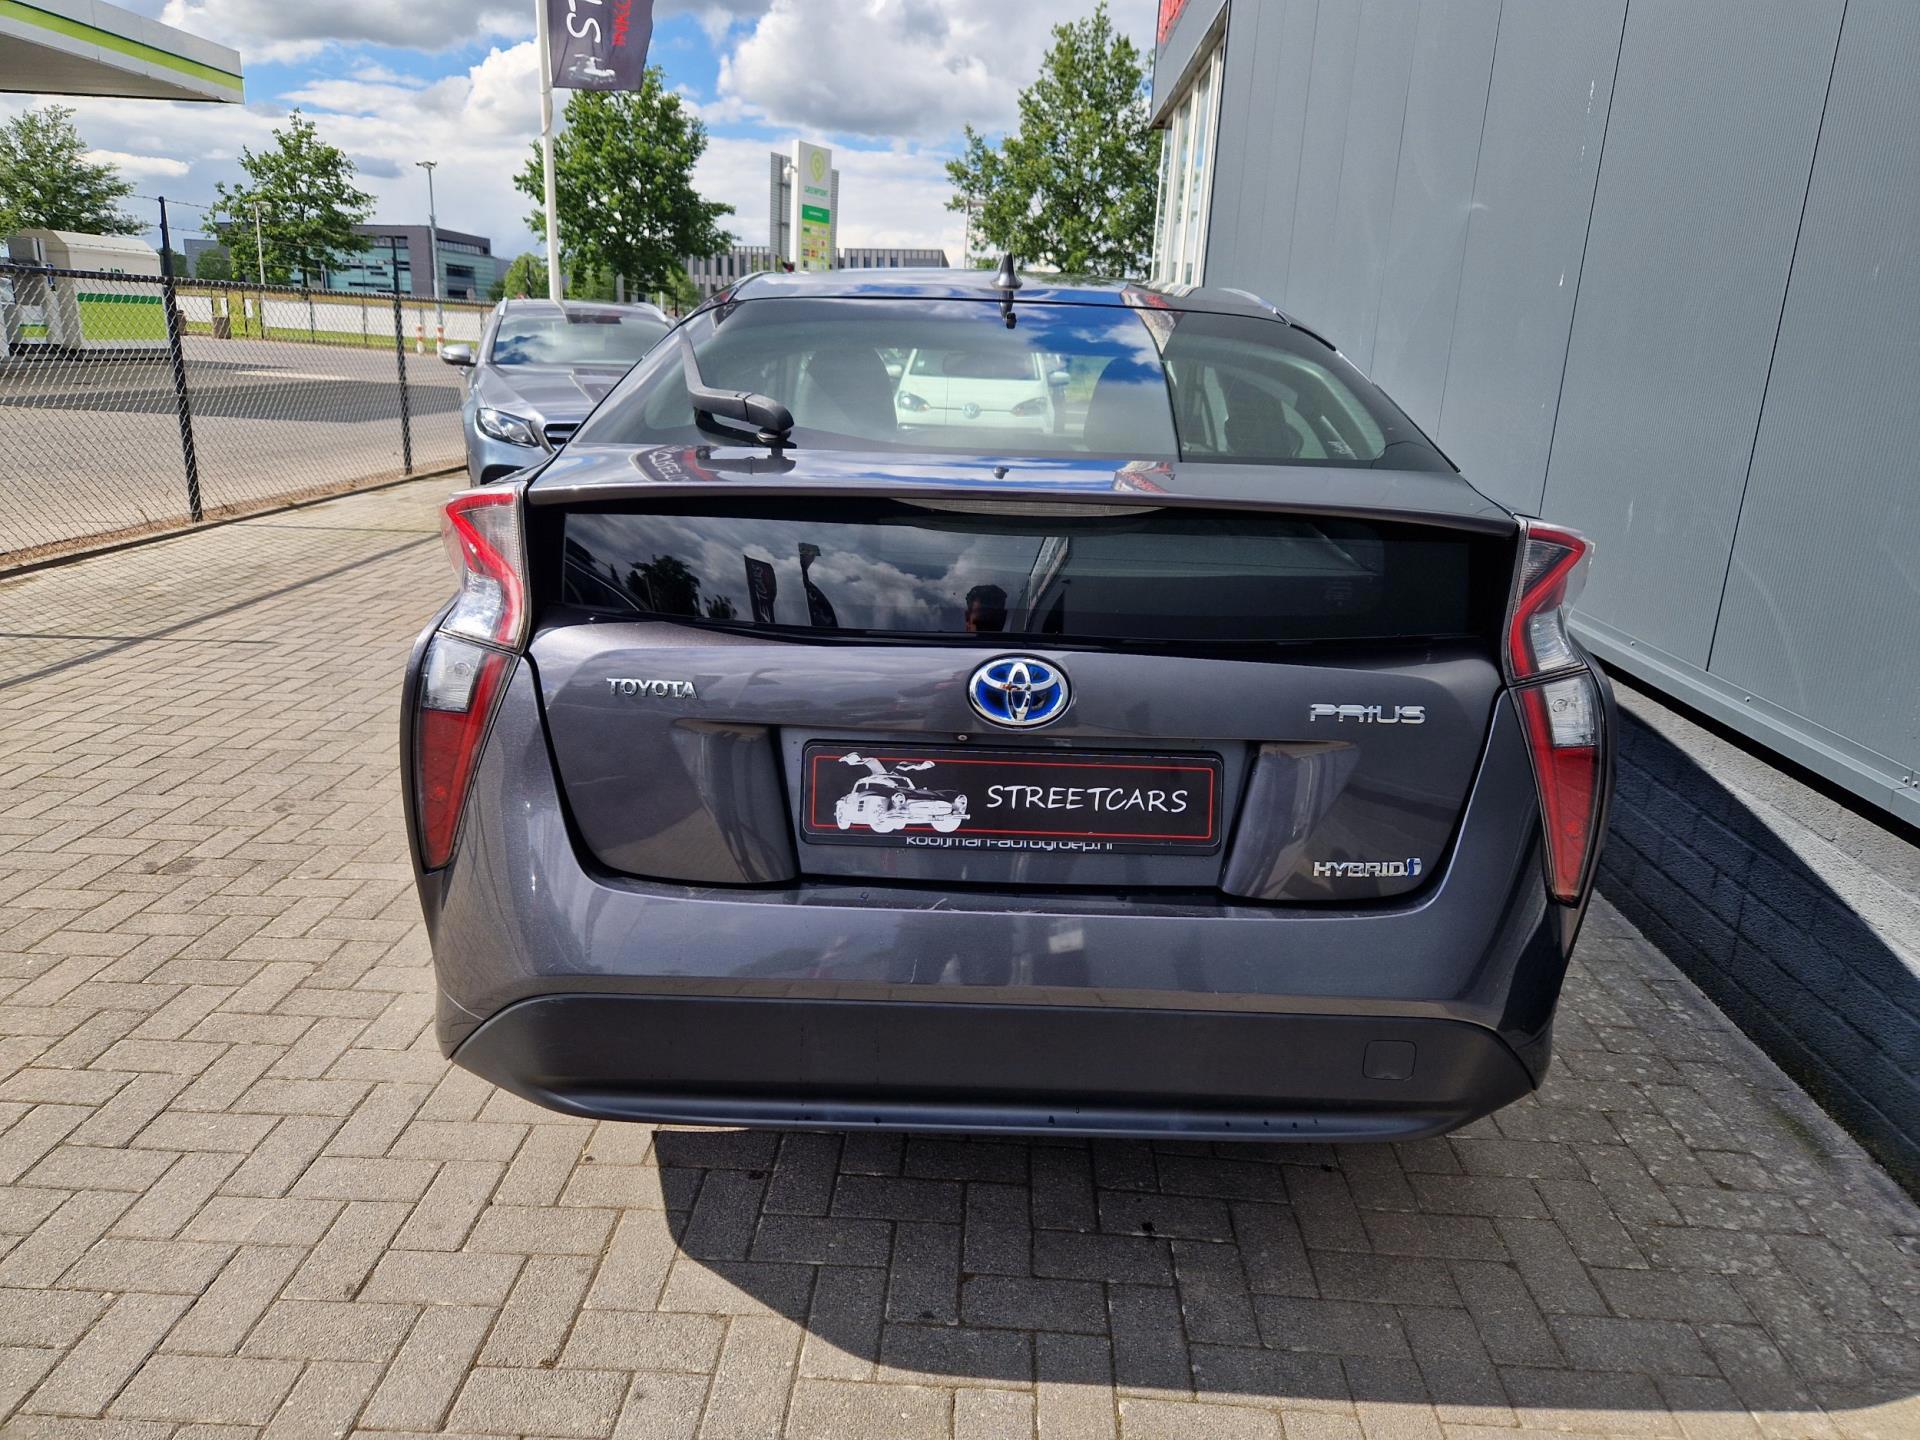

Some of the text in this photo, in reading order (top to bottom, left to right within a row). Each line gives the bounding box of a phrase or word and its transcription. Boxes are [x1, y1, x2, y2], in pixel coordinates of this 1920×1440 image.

[606, 677, 698, 699] TOYOTA
[1310, 703, 1426, 724] PRIUS
[986, 785, 1188, 812] STREETCARS
